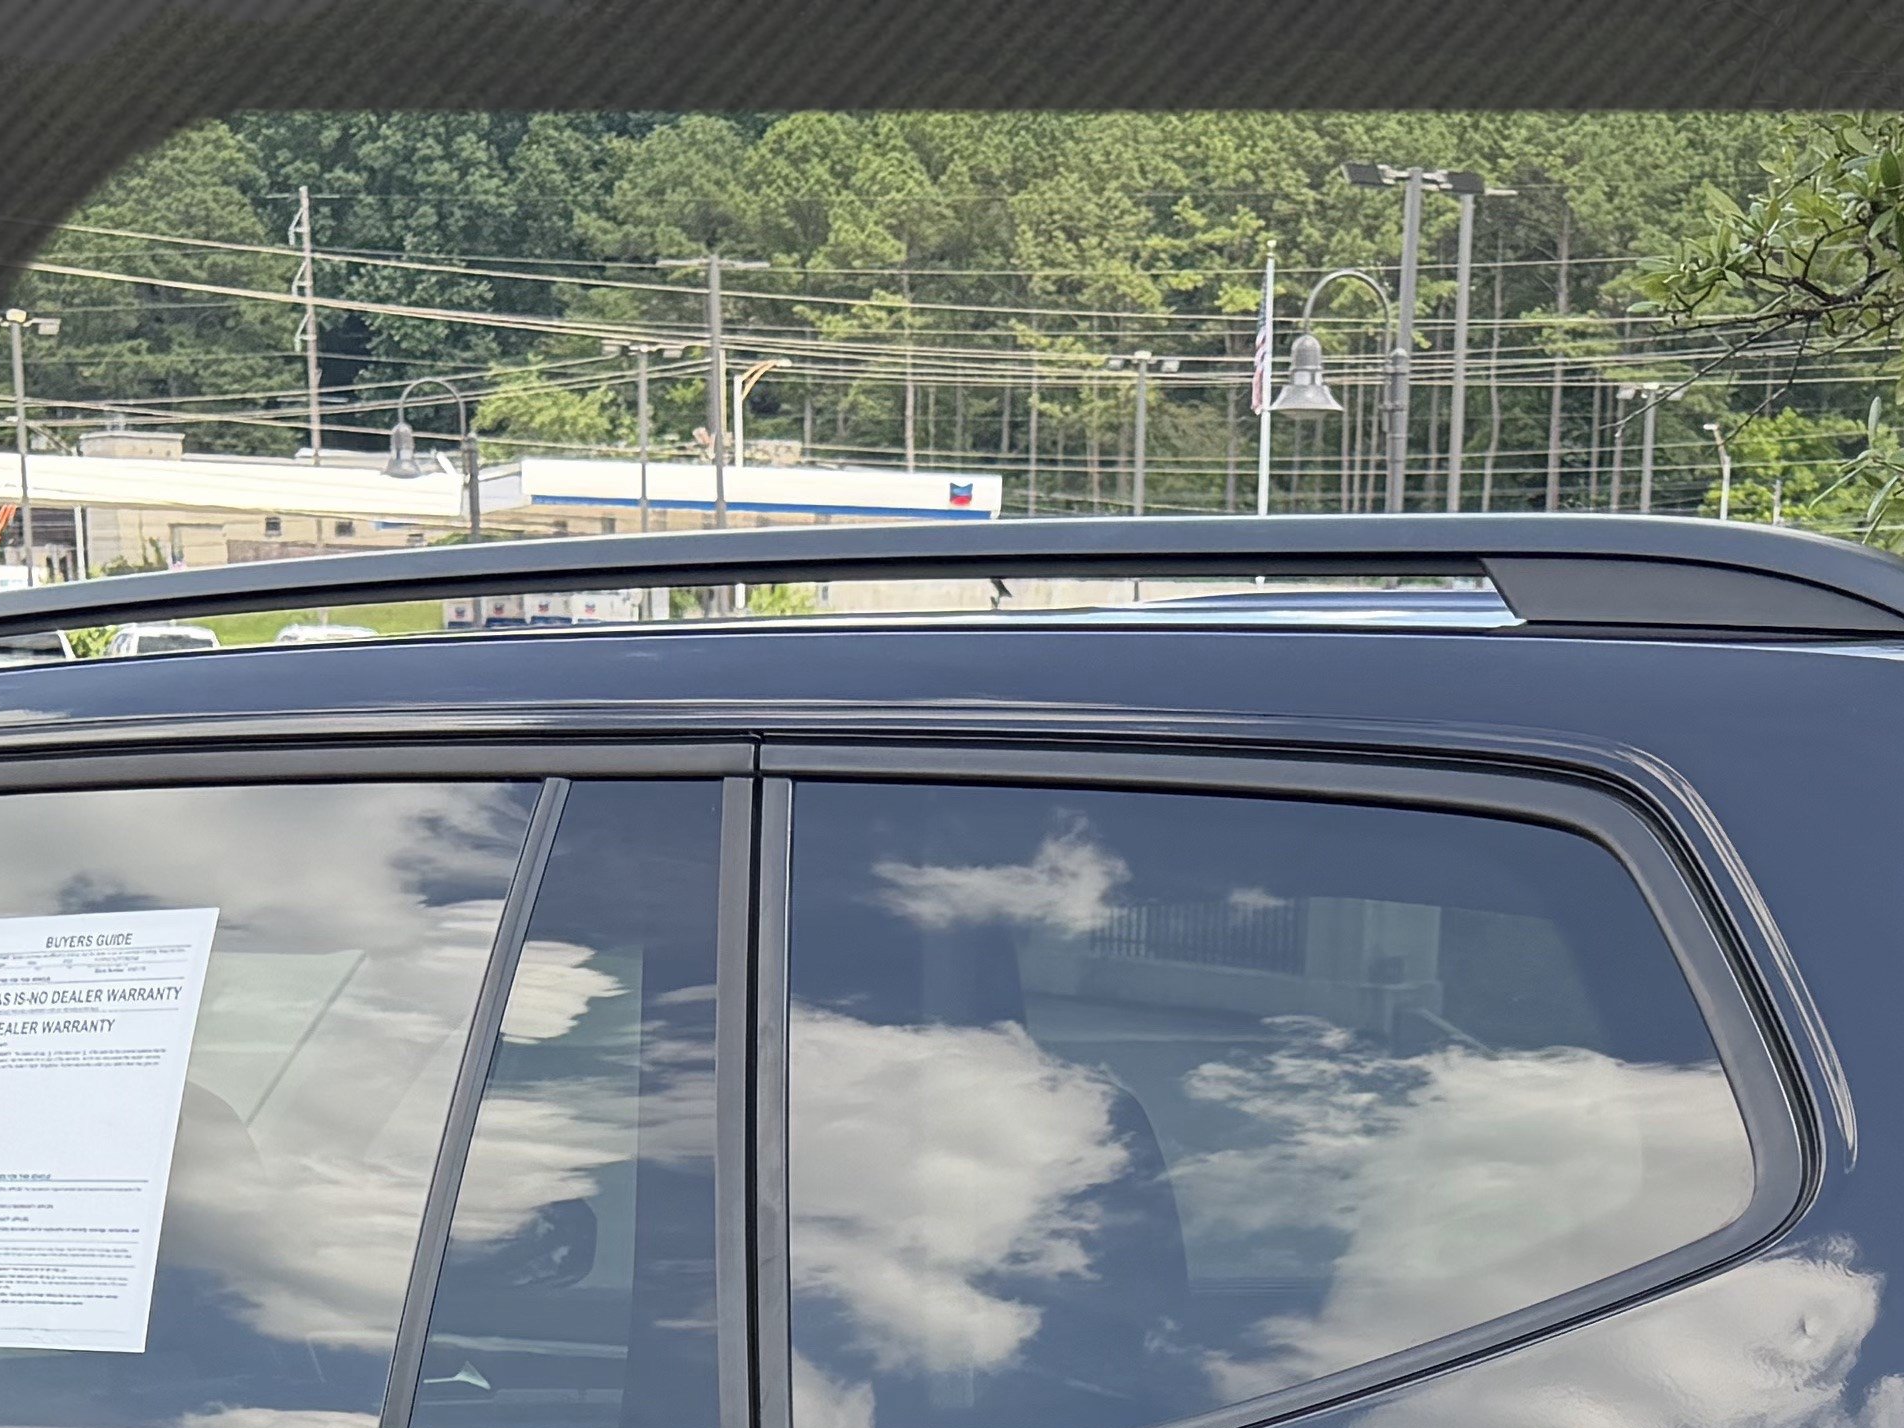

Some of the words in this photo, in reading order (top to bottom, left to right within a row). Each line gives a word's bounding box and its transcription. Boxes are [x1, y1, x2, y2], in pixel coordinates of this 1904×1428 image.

[45, 935, 93, 949] BUYERS
[96, 932, 133, 947] GUIDE
[51, 988, 103, 1004] DEALER
[106, 985, 183, 1002] WARRANTY
[42, 1018, 116, 1035] WARRANTY
